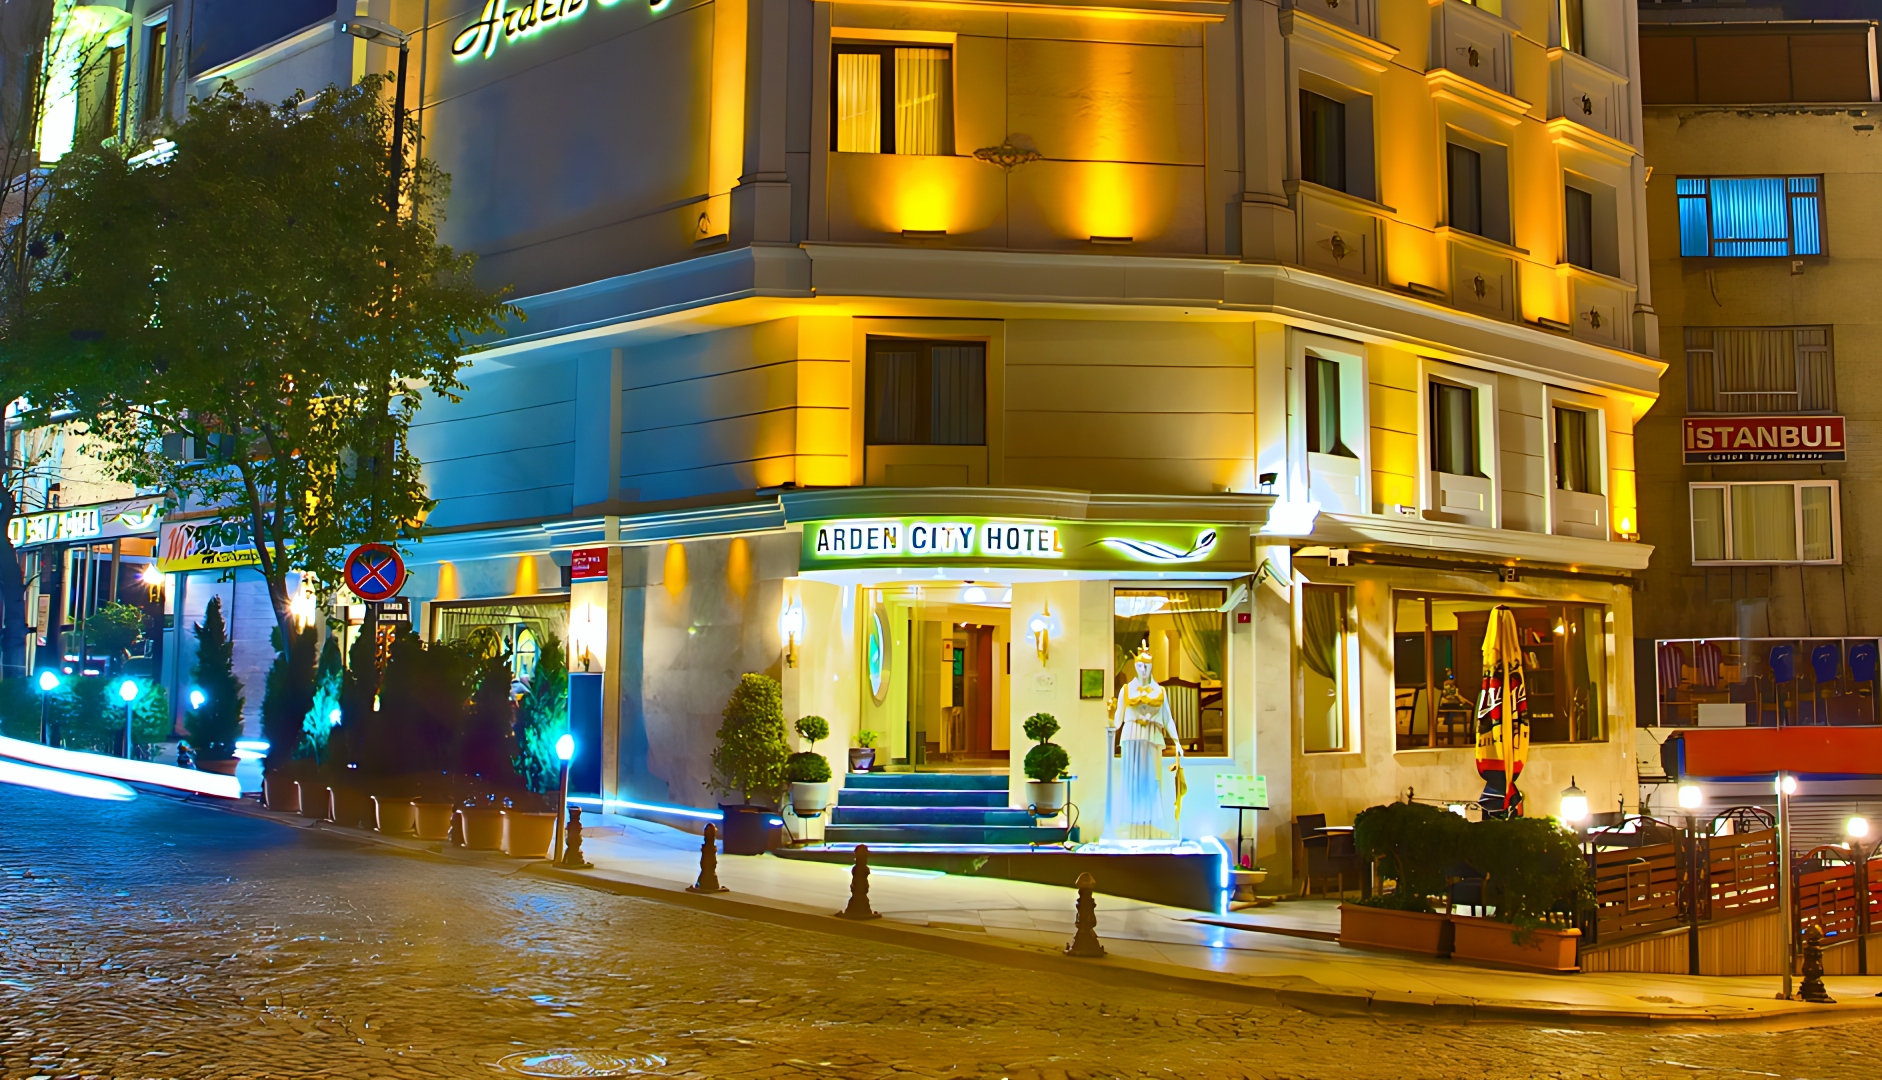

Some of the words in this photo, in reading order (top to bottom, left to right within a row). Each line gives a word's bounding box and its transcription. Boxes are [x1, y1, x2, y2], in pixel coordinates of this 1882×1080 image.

[1686, 421, 1841, 449] İSTANBUL
[816, 526, 898, 553] ARDEN
[912, 525, 973, 550] CITY
[986, 526, 1064, 554] HOTEL
